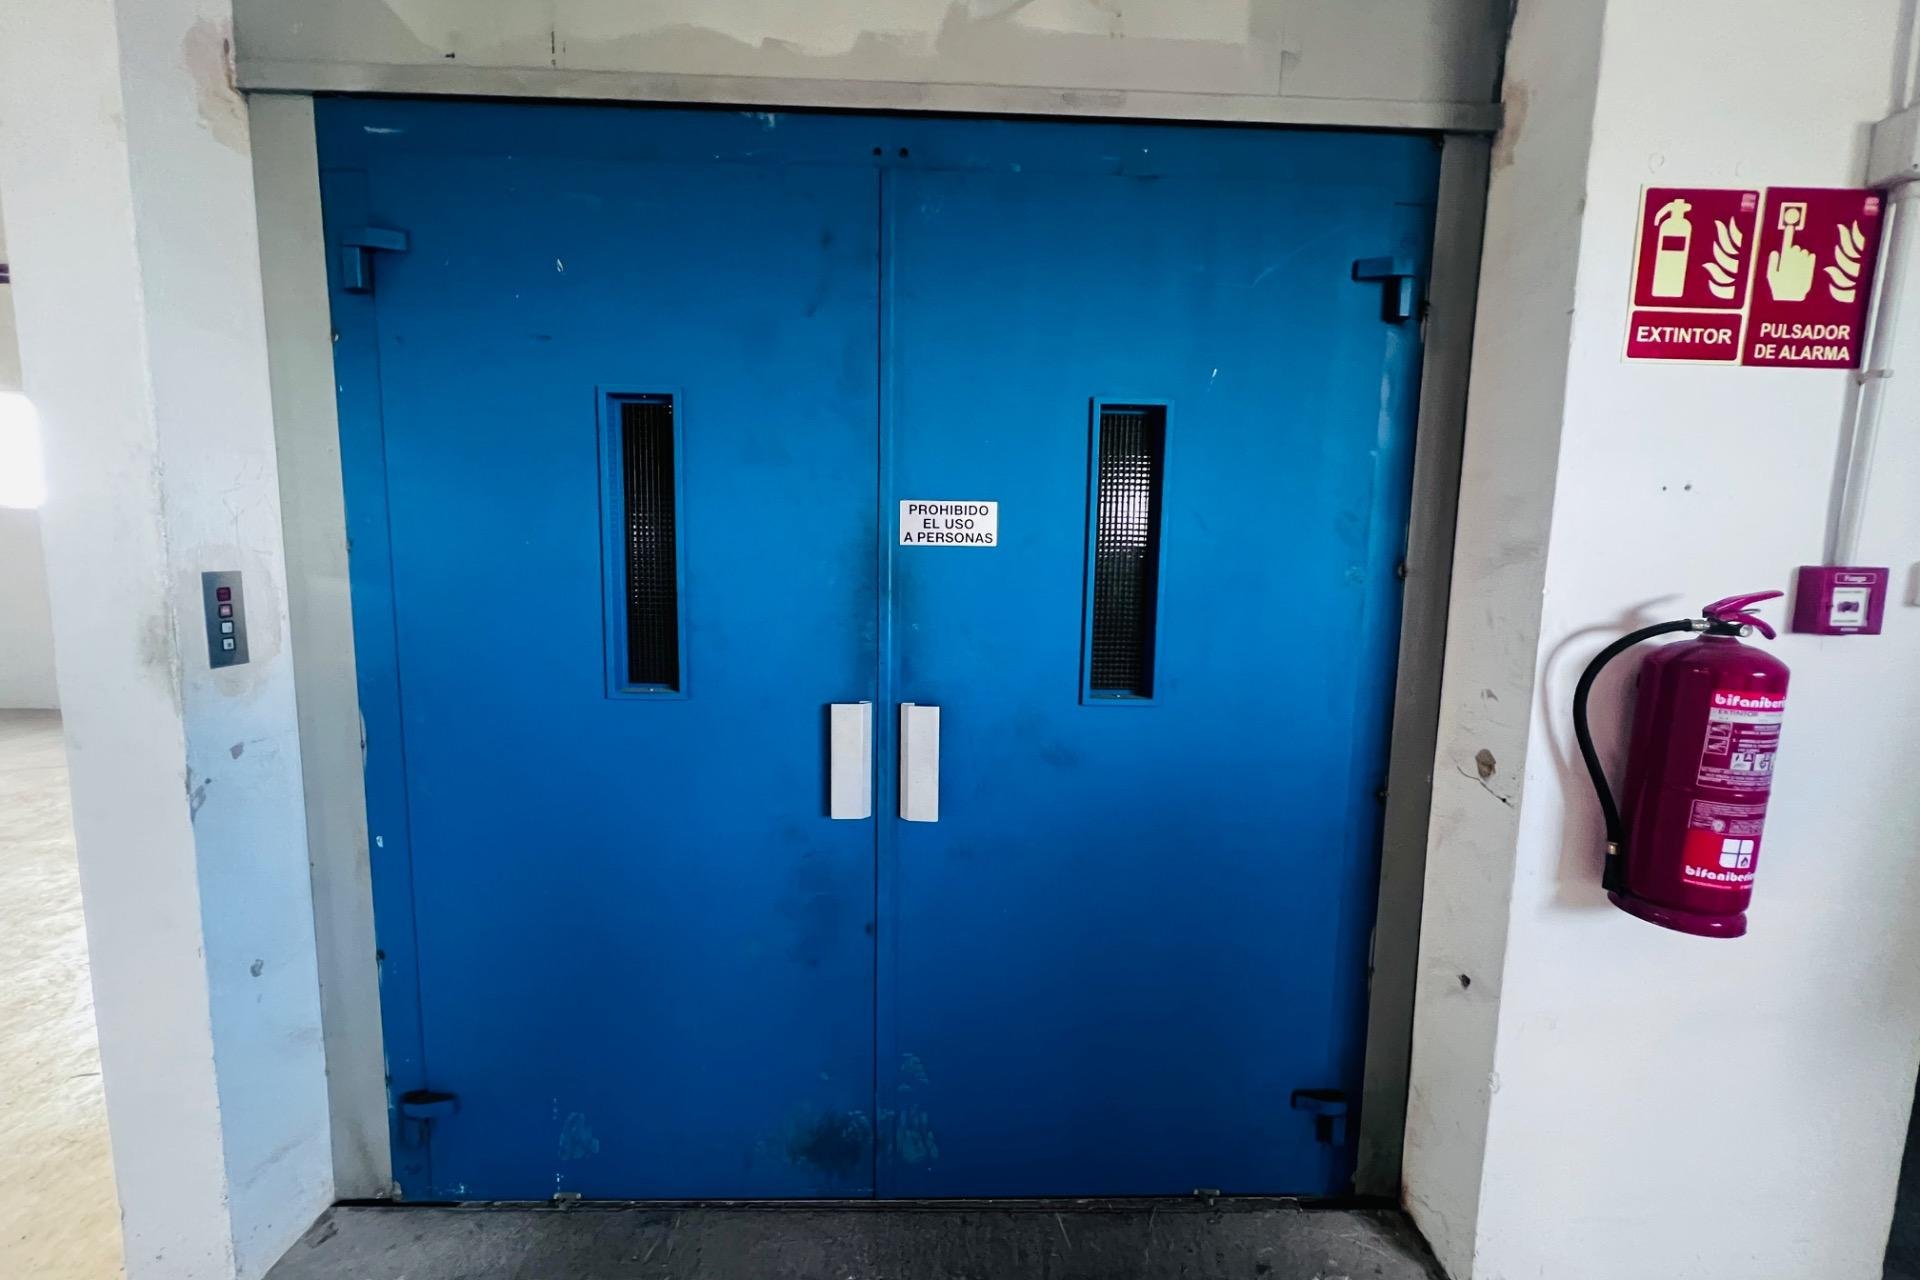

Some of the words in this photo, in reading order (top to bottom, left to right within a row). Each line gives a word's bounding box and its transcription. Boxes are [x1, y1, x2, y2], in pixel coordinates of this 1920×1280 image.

[1636, 326, 1733, 345] EXTINTOR
[1760, 323, 1851, 341] PULSADOR
[1754, 344, 1776, 360] DE
[1779, 345, 1851, 361] ALARMA
[909, 504, 989, 515] PROHIBIDO
[923, 519, 940, 529] EL
[945, 519, 974, 529] USO
[903, 532, 913, 542] A
[917, 532, 993, 544] PERSONAS
